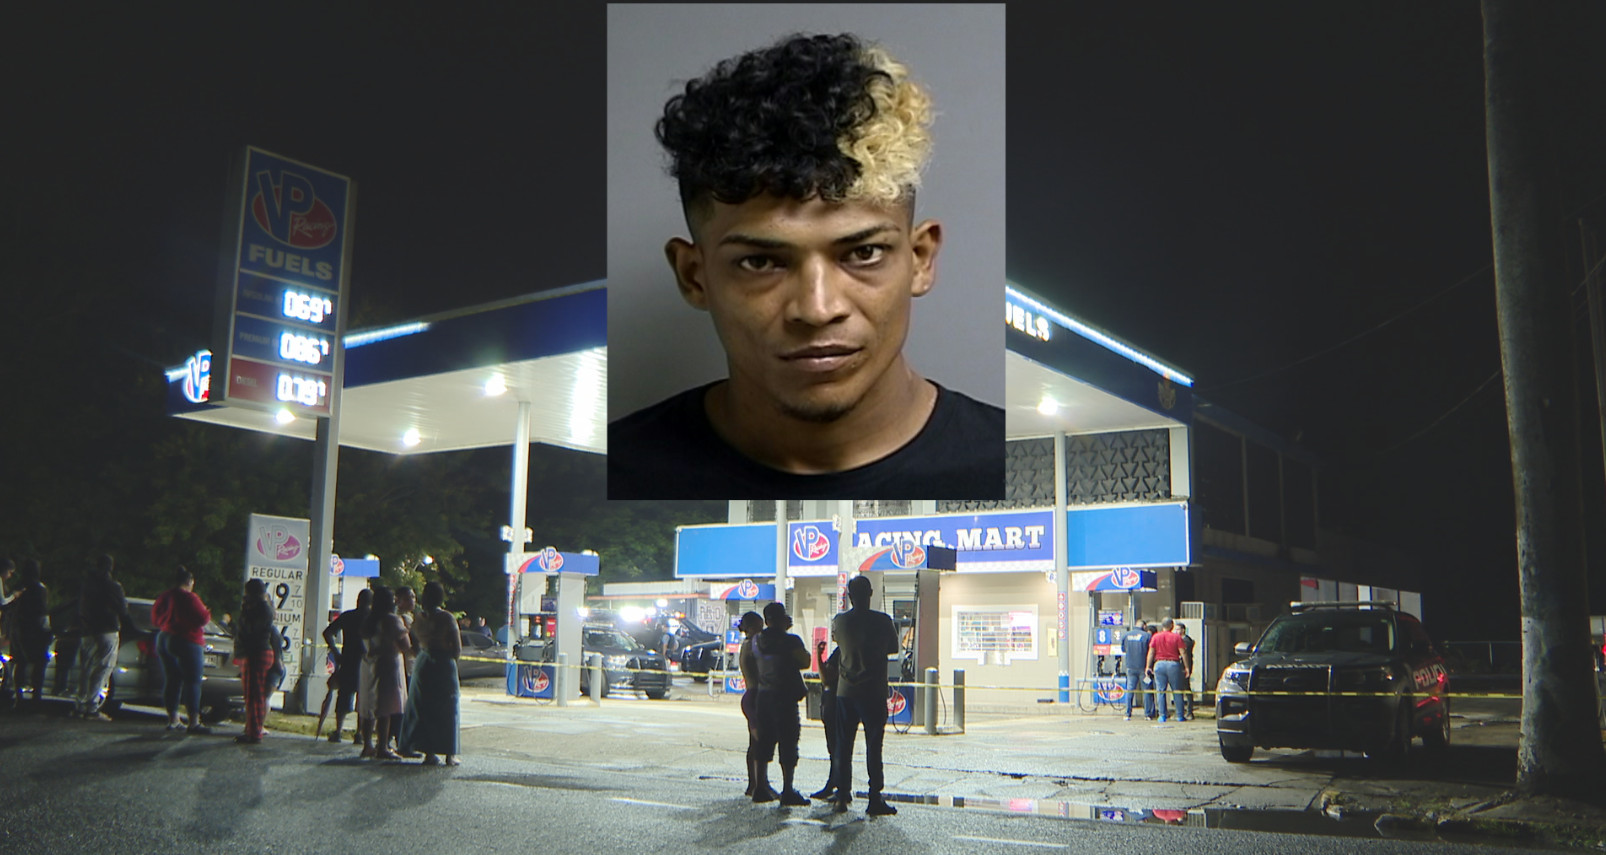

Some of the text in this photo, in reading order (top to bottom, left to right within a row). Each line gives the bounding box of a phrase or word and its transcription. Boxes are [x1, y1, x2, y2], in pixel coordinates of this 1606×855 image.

[256, 169, 316, 245] VP
[249, 244, 332, 280] FUELS
[259, 524, 289, 559] VP
[795, 526, 819, 559] VP
[957, 525, 1045, 551] MART
[540, 547, 556, 570] VP
[893, 539, 915, 566] VP
[252, 567, 303, 580] REGULAR
[1113, 567, 1131, 587] VP
[739, 580, 752, 597] VP
